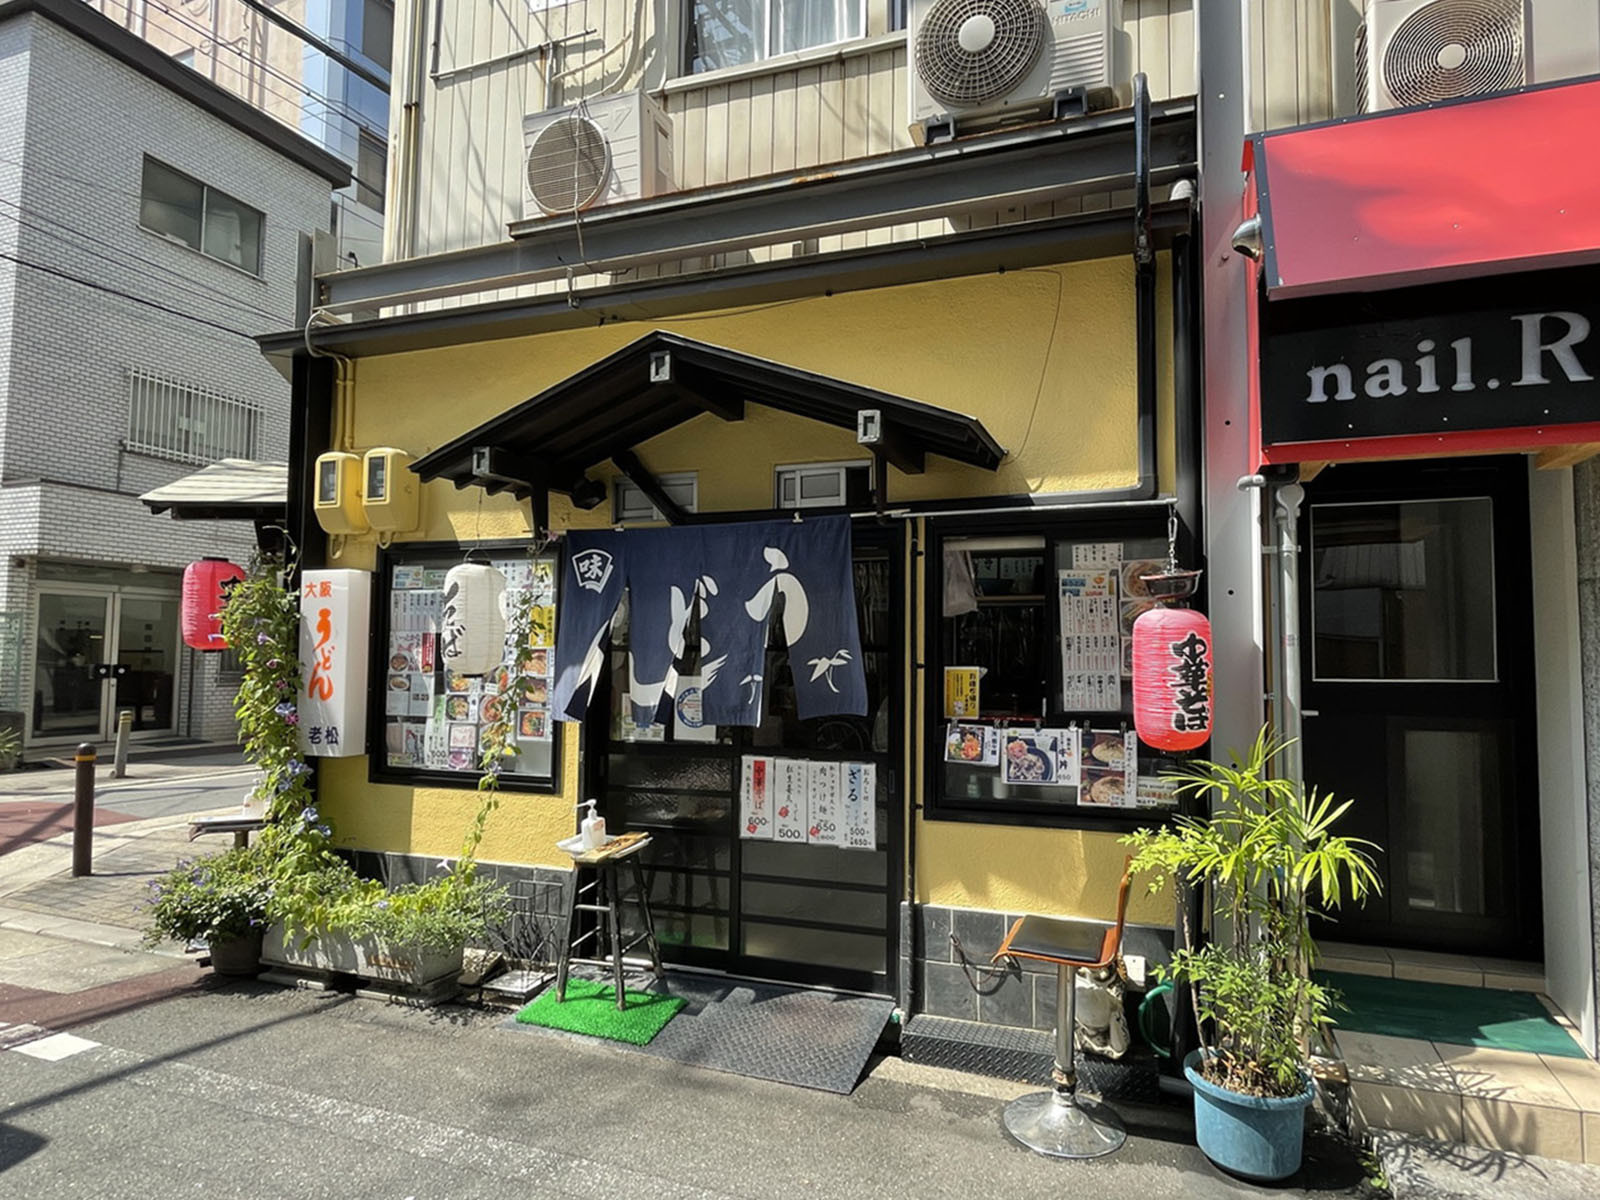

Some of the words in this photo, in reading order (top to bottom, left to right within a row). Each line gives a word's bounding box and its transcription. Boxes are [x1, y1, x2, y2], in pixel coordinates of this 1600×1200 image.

[1052, 7, 1101, 25] HITACHI
[1306, 310, 1594, 404] nail.R
[580, 553, 604, 580] 味
[304, 581, 332, 598] 大阪
[308, 608, 335, 702] うどん
[1170, 632, 1209, 731] 中華そば
[308, 726, 339, 745] 老松
[848, 768, 861, 802] ざる
